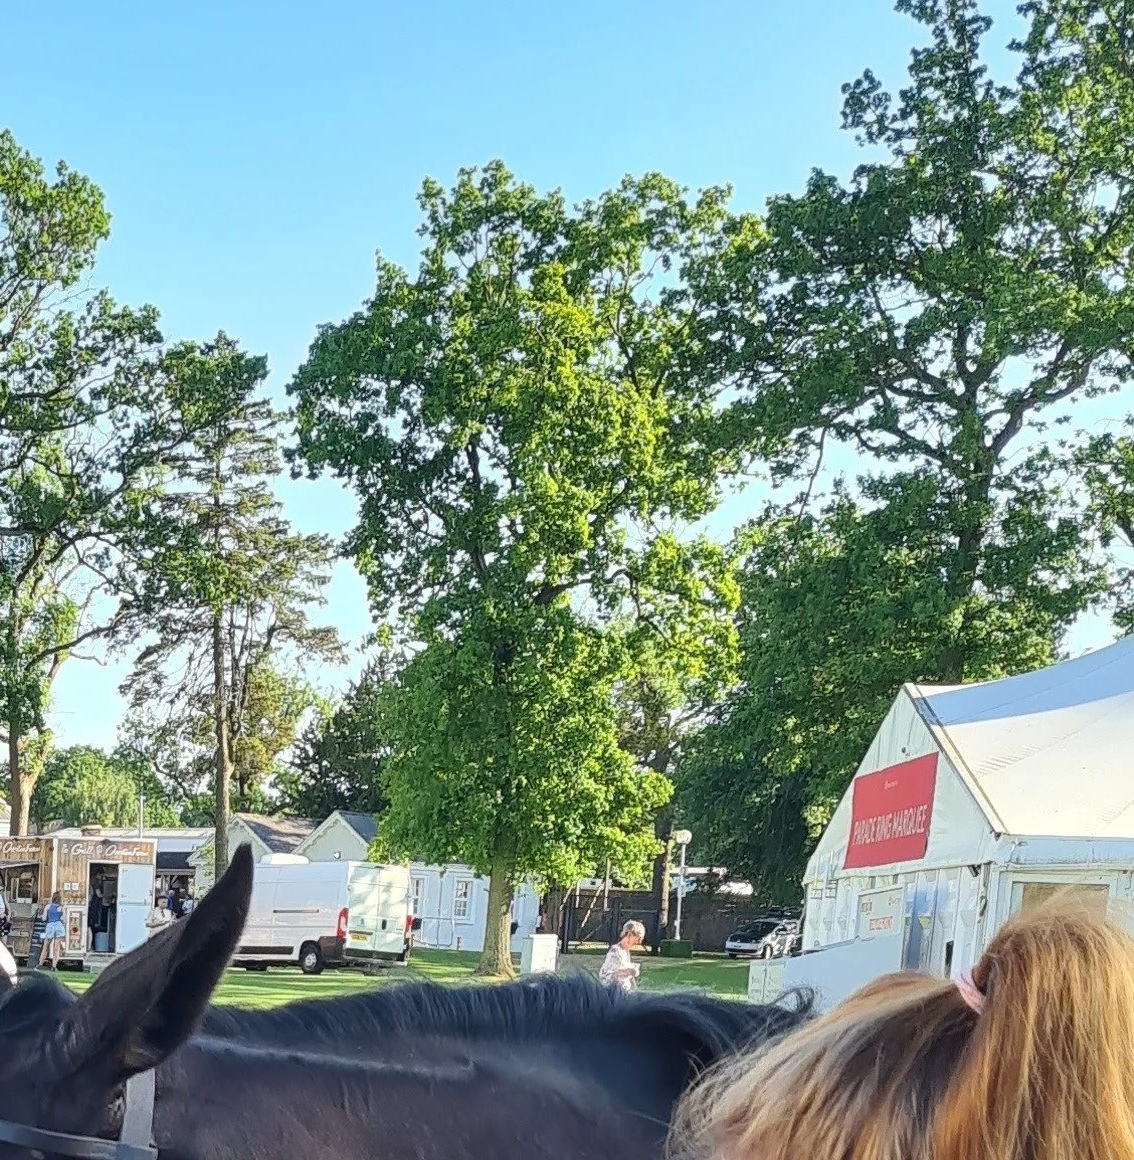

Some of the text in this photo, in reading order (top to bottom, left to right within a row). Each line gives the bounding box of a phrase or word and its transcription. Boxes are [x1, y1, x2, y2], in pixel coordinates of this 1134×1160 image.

[852, 804, 927, 846] PARADE RING MARQUEE
